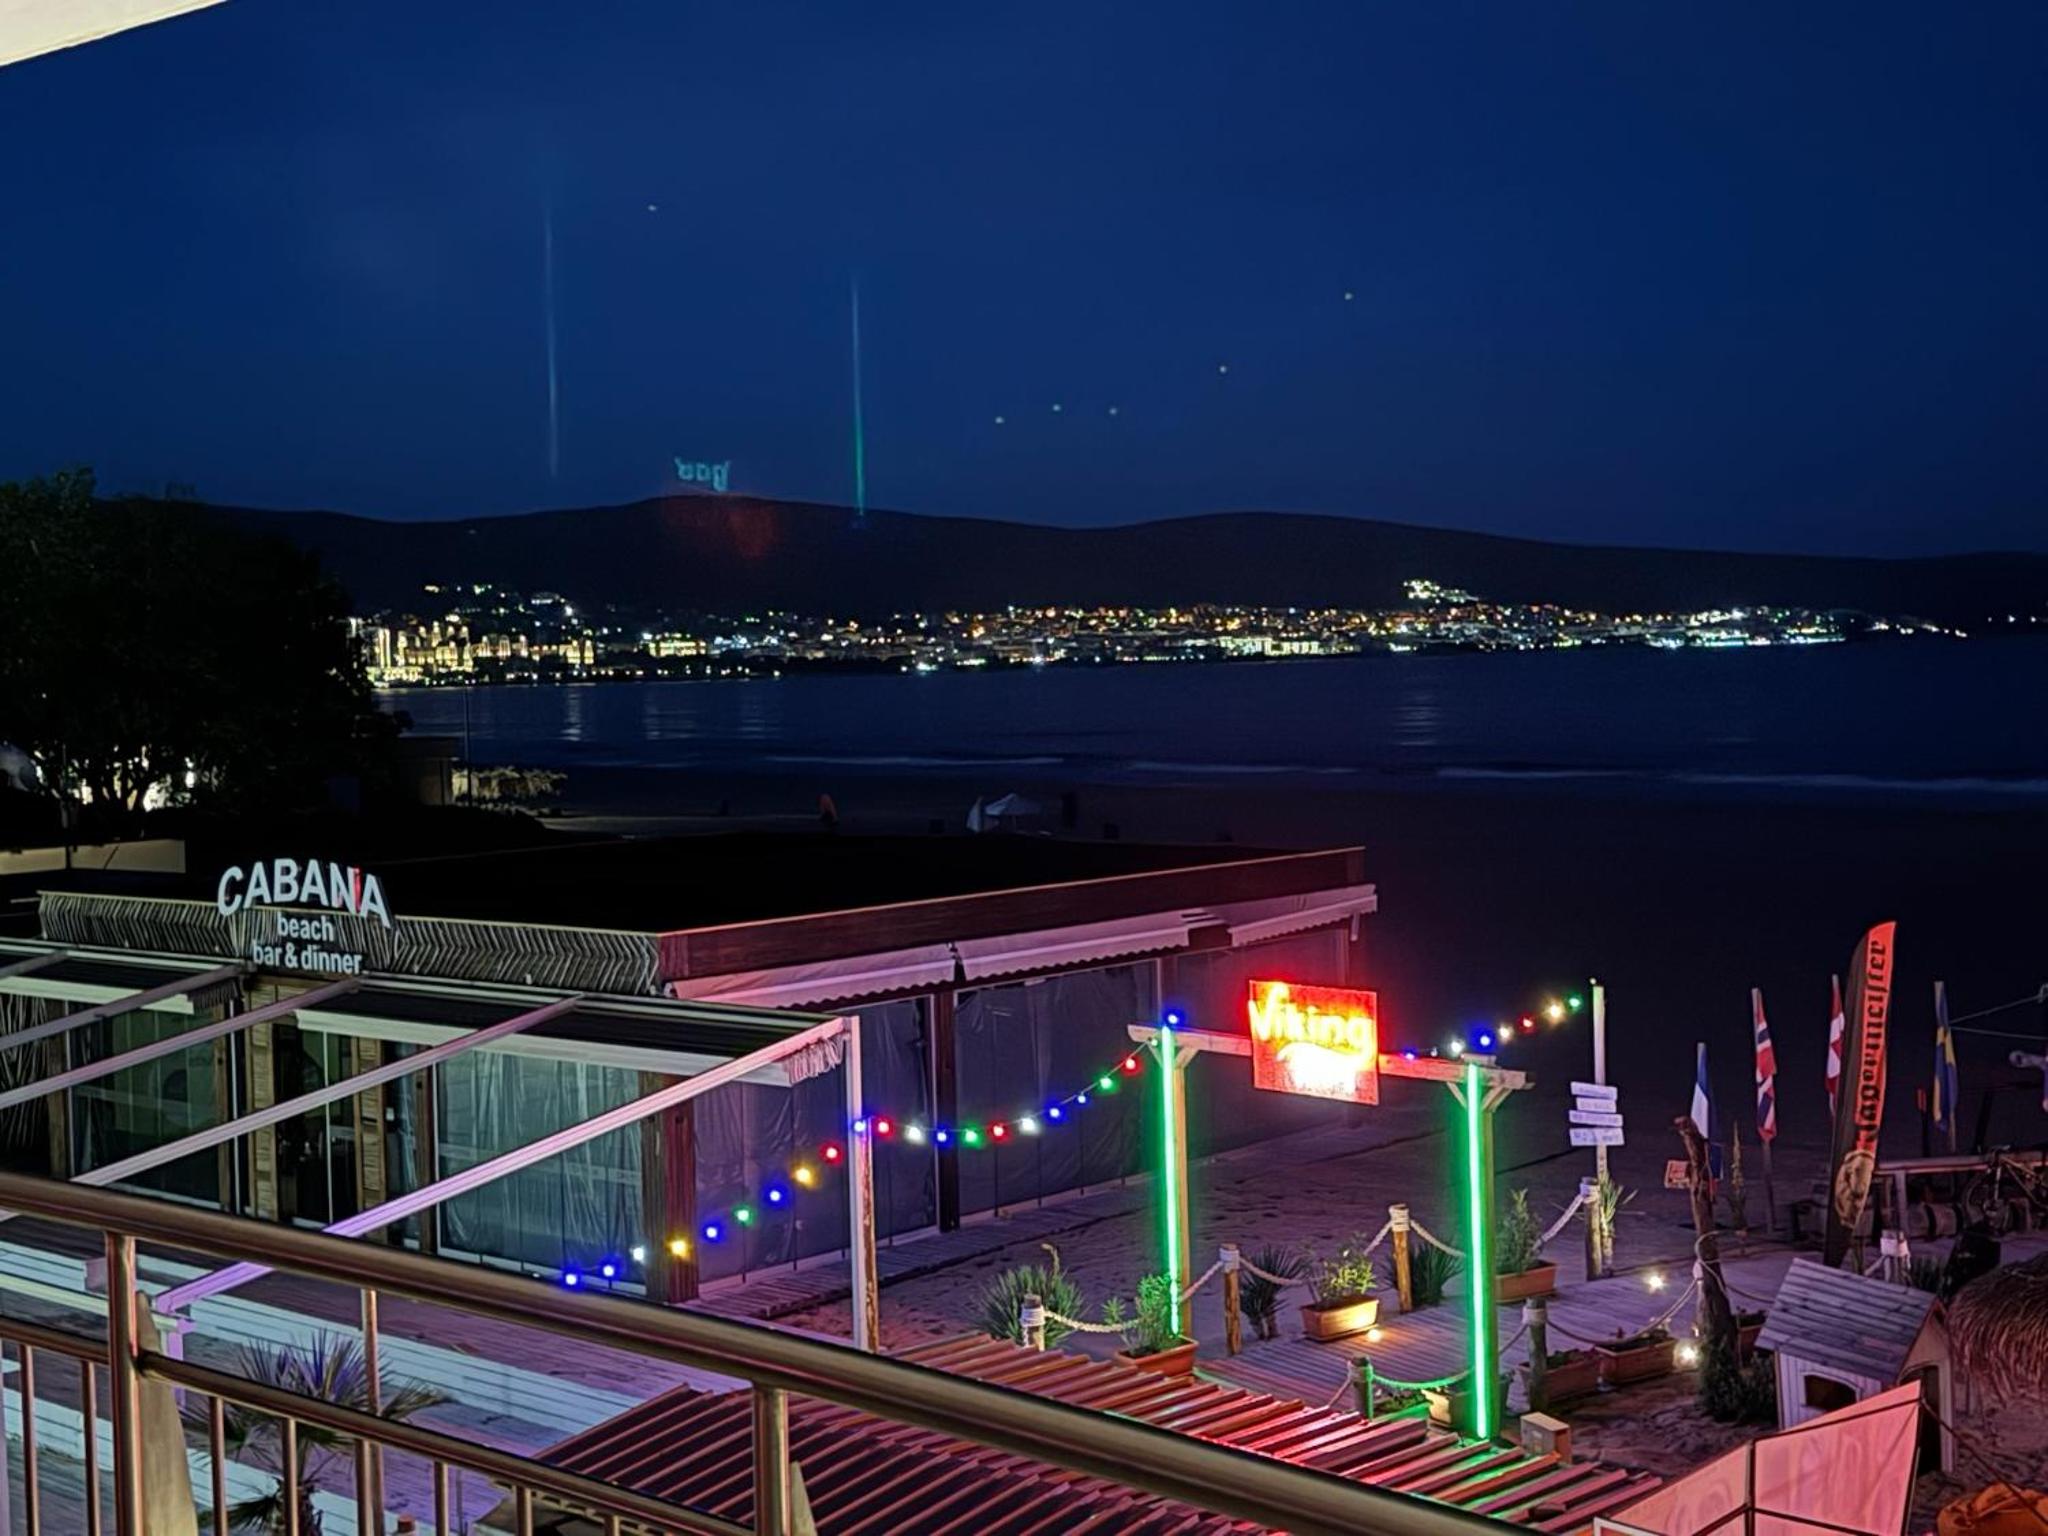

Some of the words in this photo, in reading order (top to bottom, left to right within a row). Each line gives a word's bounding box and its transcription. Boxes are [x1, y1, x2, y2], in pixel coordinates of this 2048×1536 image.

[217, 857, 391, 929] CABANA
[276, 911, 335, 942] beach
[252, 939, 282, 967] bar
[284, 942, 299, 970] &
[300, 944, 363, 975] dinner
